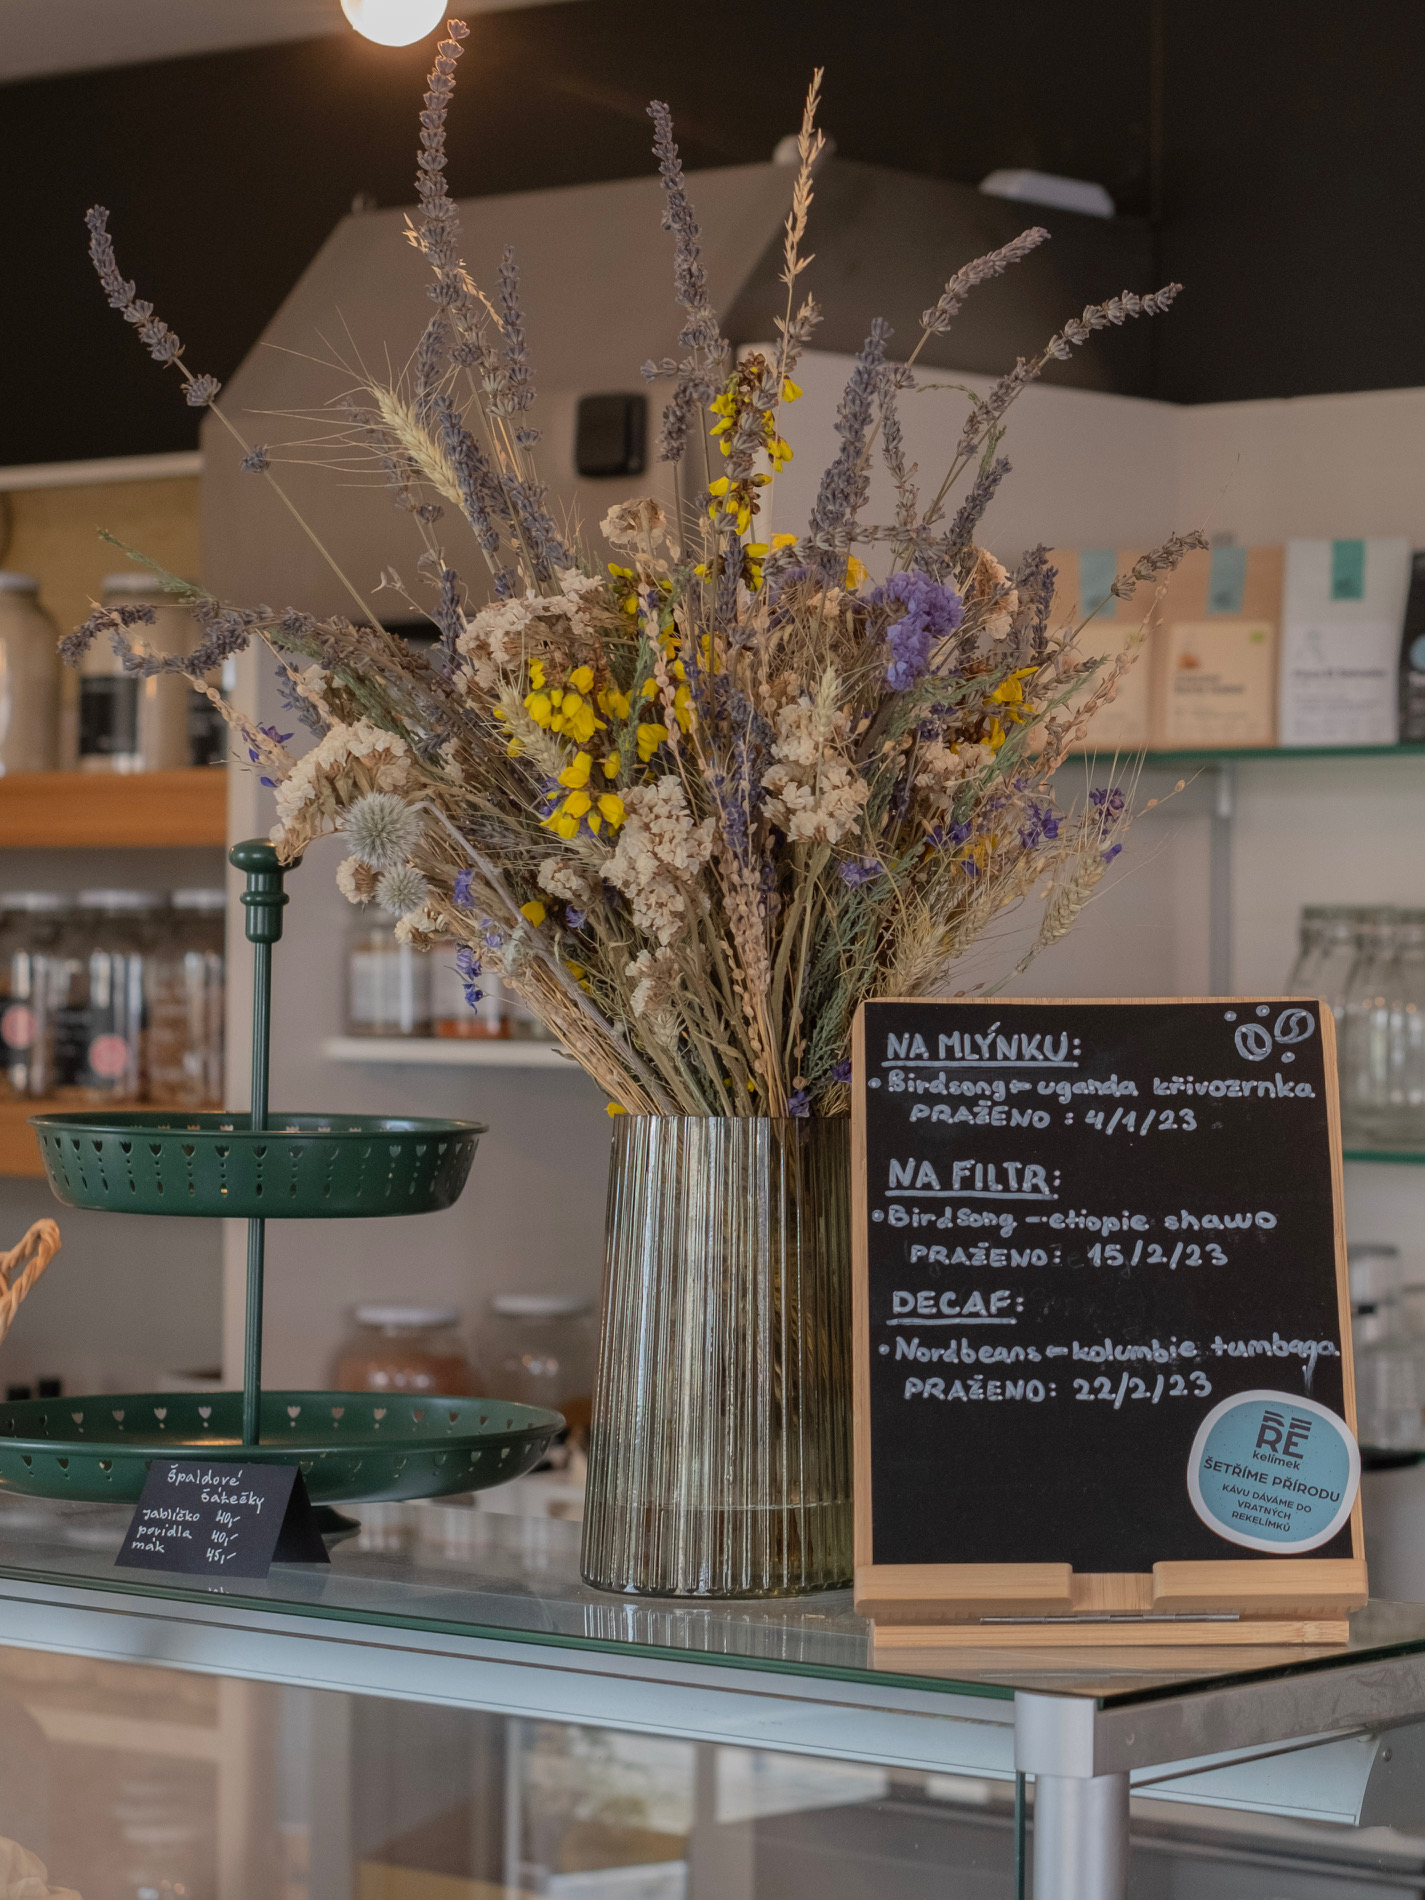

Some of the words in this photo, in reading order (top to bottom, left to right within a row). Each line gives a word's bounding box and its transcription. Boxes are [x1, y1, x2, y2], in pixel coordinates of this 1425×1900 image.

[887, 1032, 930, 1062] NA
[939, 1021, 1082, 1063] MLÝNKU:
[888, 1069, 1006, 1102] Birdsong
[1037, 1074, 1139, 1104] uganda
[1085, 1106, 1198, 1137] 4/1/23
[889, 1157, 940, 1191] NA
[952, 1159, 1062, 1195] FILTR:
[1049, 1208, 1150, 1237] etiopie
[1164, 1210, 1279, 1231] shawo
[1087, 1239, 1229, 1270] 15/2/23
[891, 1289, 1025, 1318] DECAF:
[895, 1336, 1043, 1364] Nordbeans
[1072, 1336, 1198, 1364] kolumbie
[1210, 1332, 1341, 1380] tumbaga
[1073, 1371, 1213, 1410] 22/2/23
[1255, 1410, 1312, 1460] RE
[1252, 1450, 1301, 1471] kelímek
[1203, 1455, 1269, 1485] ŠETŘÍME
[1272, 1475, 1341, 1503] PŘÍRODU
[1222, 1483, 1250, 1497] KÁVU
[1252, 1491, 1295, 1509] DÁVÁME
[1296, 1503, 1312, 1513] DO
[1237, 1500, 1292, 1521] VRATNÝCH
[1231, 1511, 1291, 1533] REKELÍMKŮ
[131, 1537, 165, 1553] mák
